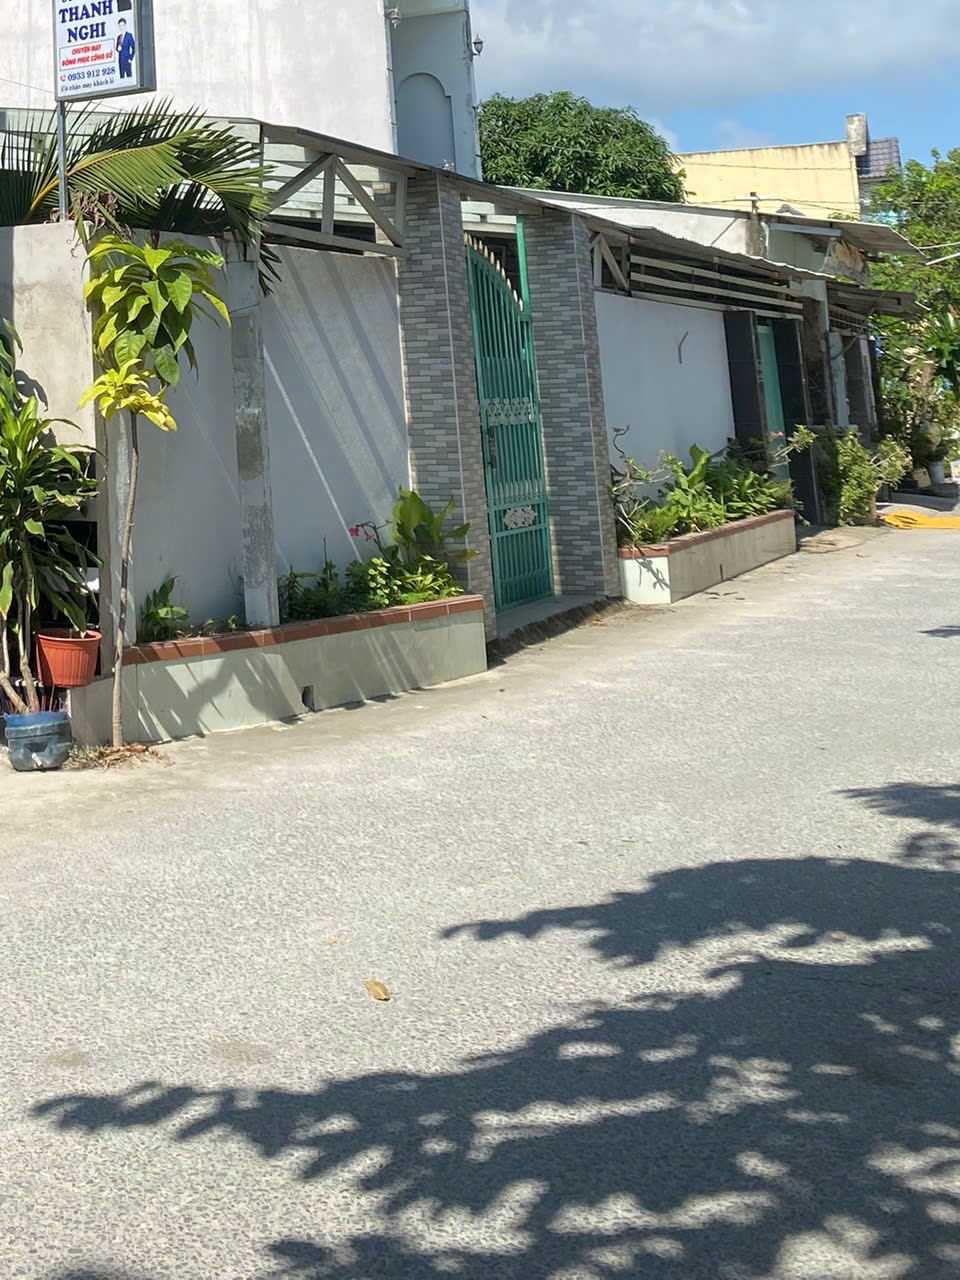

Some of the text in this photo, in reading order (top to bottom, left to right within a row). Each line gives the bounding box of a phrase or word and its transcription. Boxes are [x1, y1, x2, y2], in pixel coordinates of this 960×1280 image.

[58, 0, 113, 24] THANH
[67, 21, 106, 43] NGHI
[67, 66, 116, 82] 0933 912 928
